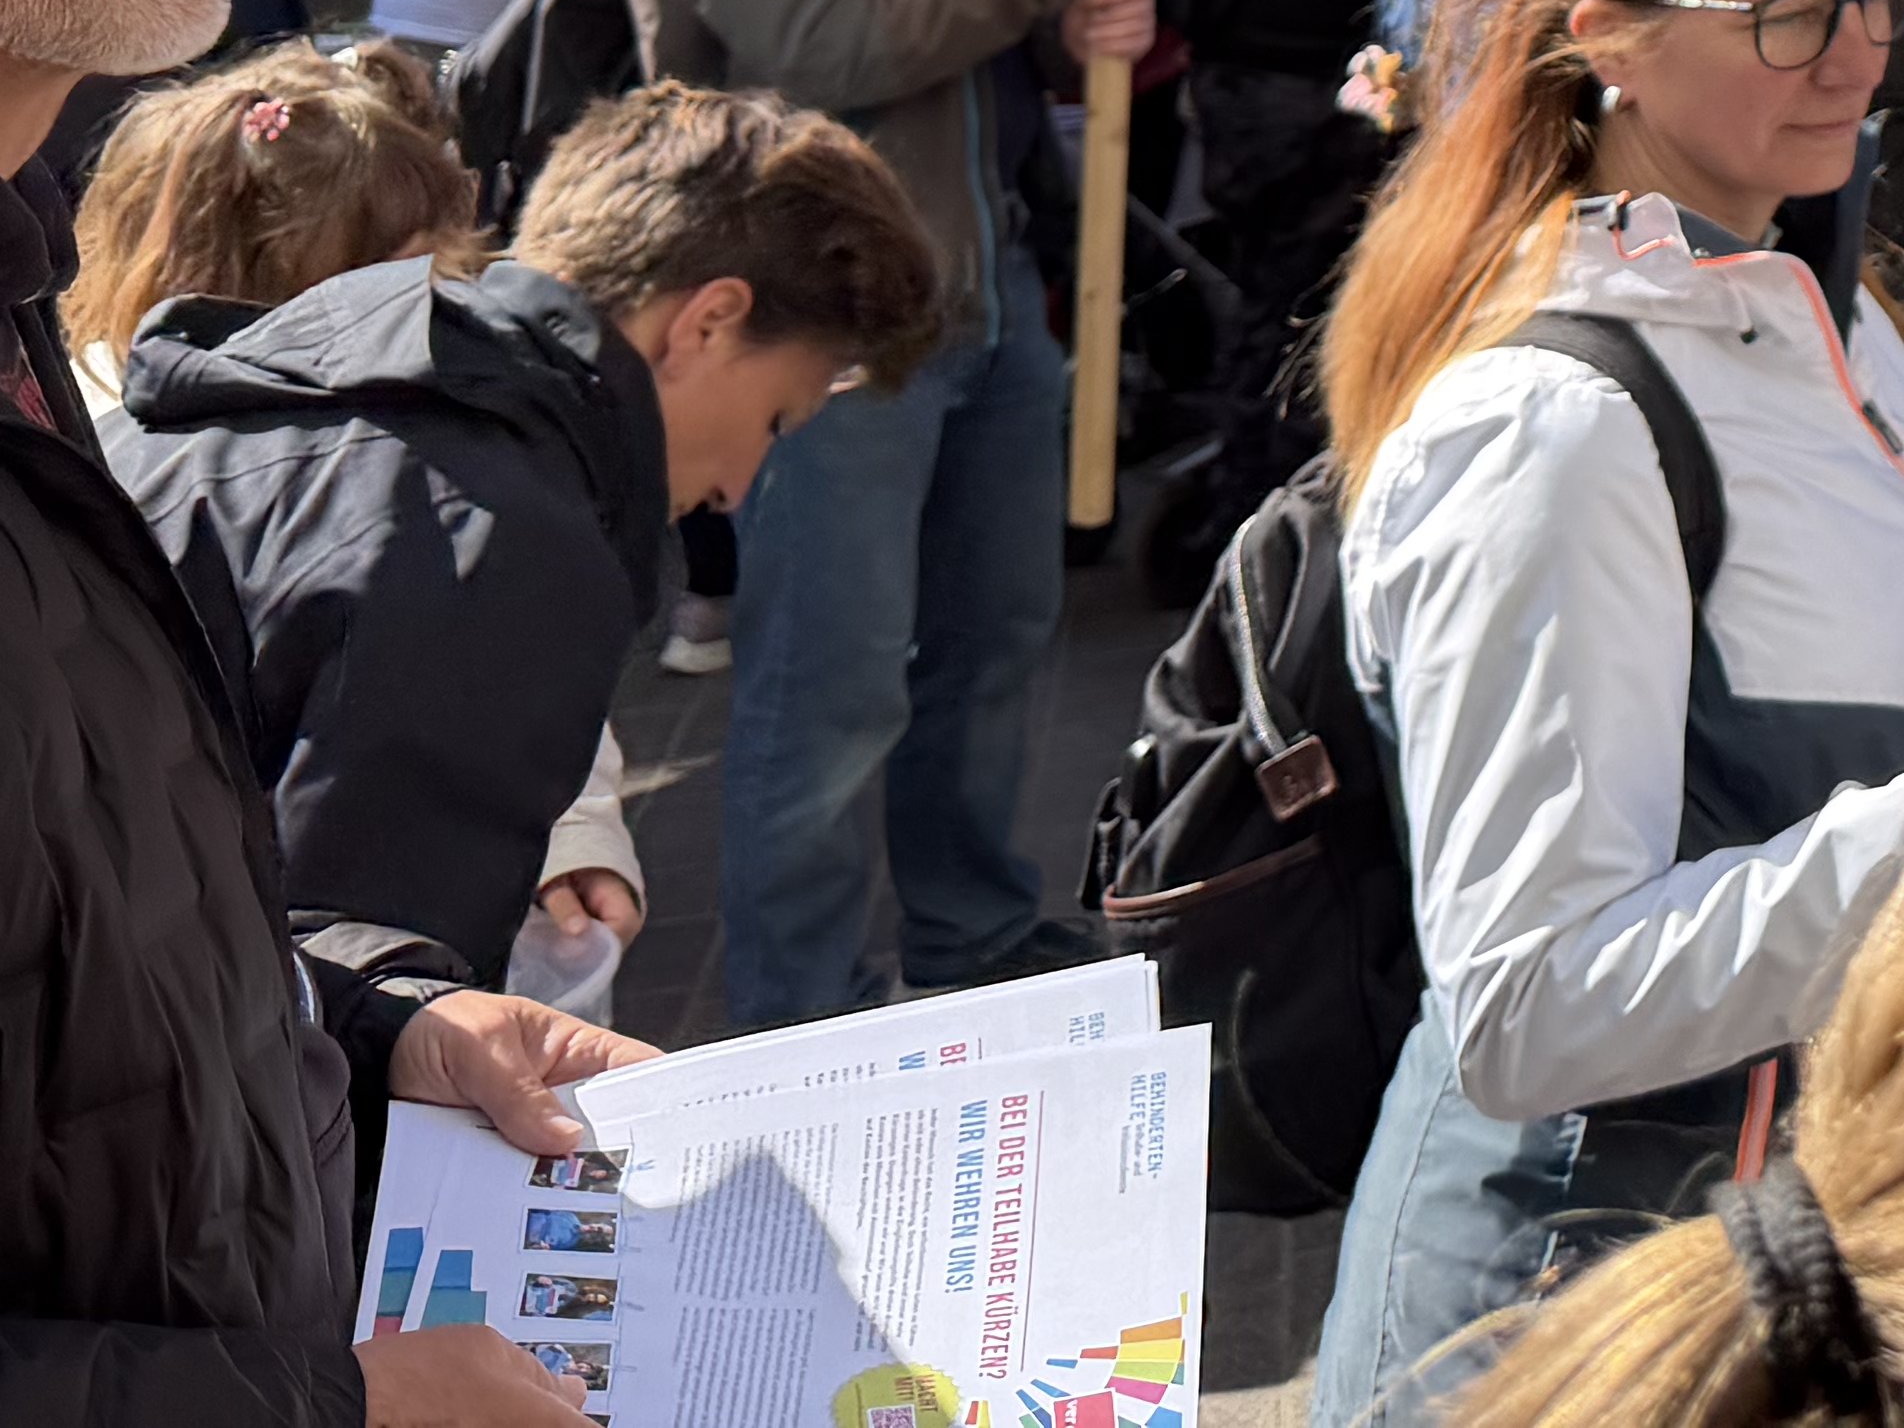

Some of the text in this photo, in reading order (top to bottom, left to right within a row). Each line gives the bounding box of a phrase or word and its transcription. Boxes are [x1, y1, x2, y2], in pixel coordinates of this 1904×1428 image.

[1130, 1074, 1146, 1120] HILFE
[944, 1100, 988, 1294] WIR WEHREN UNS!
[978, 1095, 1028, 1379] BEI DER TEILHABE KÜRZEN?
